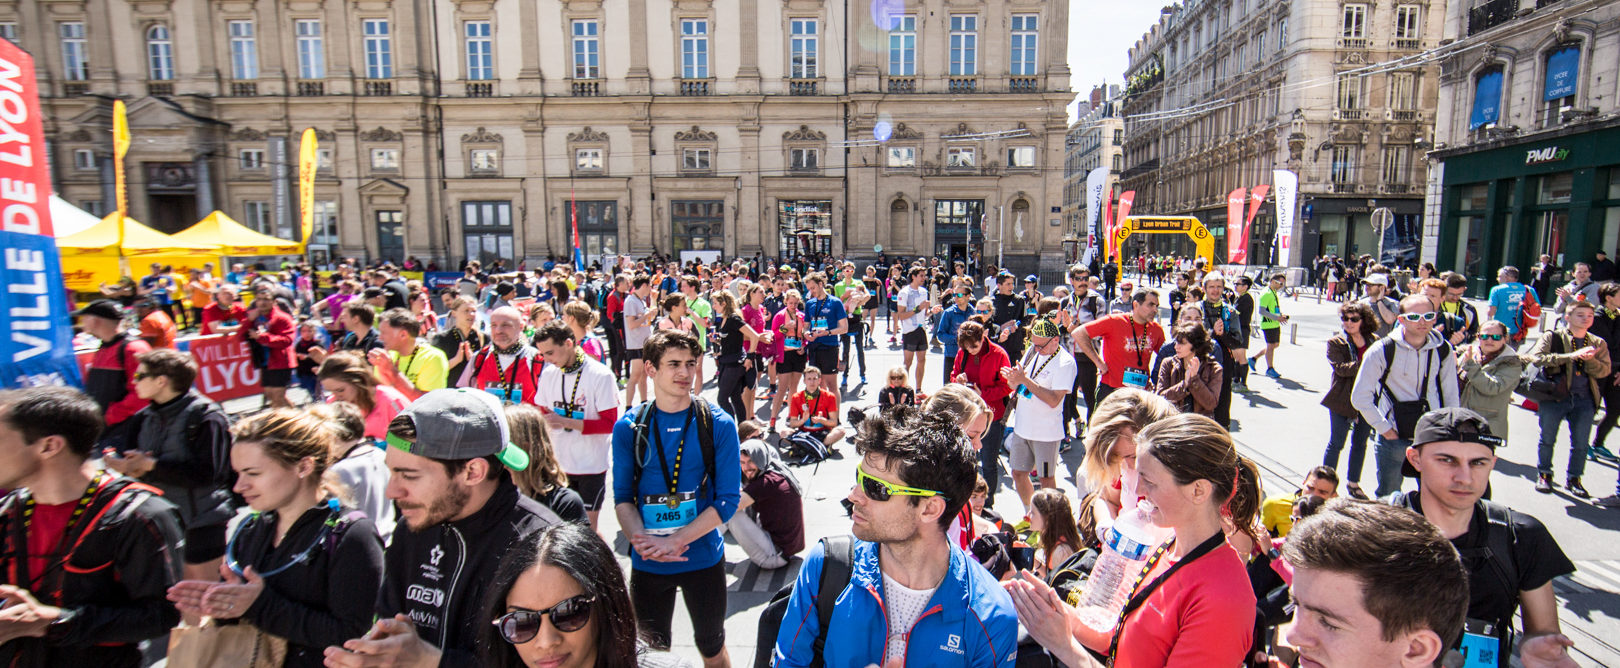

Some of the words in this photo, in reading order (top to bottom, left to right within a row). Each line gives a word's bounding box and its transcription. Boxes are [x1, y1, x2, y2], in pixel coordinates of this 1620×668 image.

[1548, 86, 1572, 97] COIFFURE
[0, 57, 33, 168] LYON
[0, 177, 41, 236] DE
[5, 247, 52, 363] VILLE
[196, 341, 251, 363] VILLE
[655, 511, 681, 523] 2465
